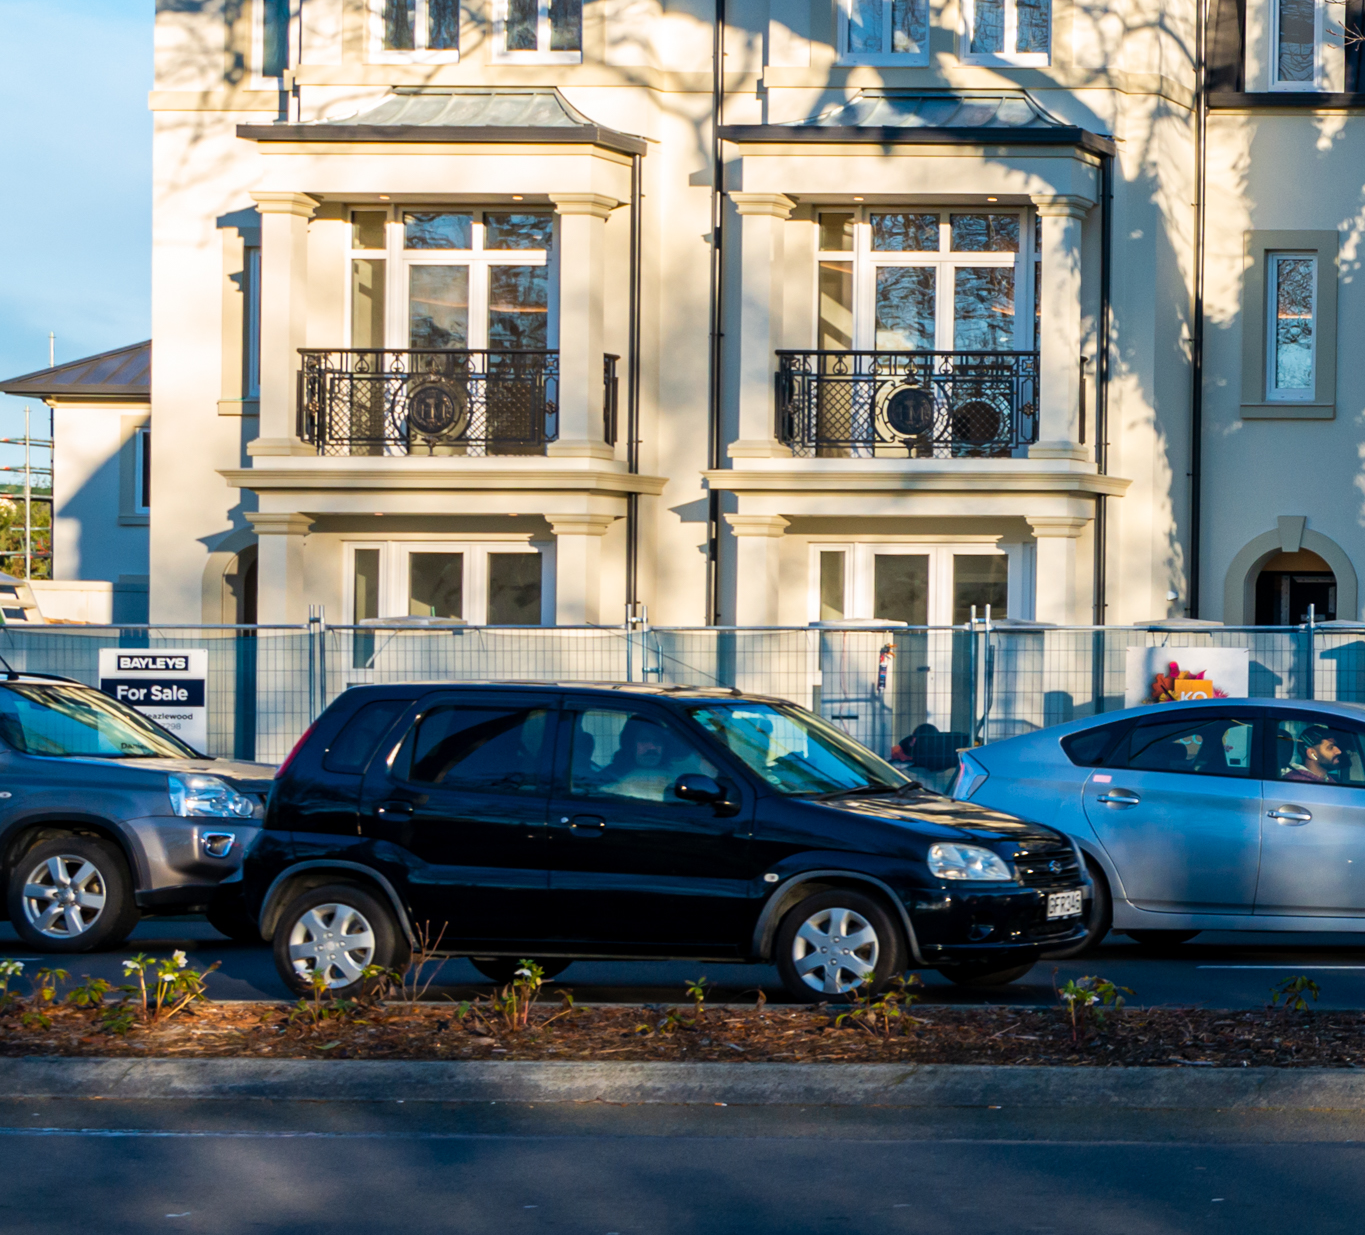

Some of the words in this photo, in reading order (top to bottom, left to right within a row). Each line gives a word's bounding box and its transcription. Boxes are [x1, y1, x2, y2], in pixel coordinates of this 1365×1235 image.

[120, 657, 186, 669] BAYLEYS
[116, 685, 147, 701] For
[150, 685, 189, 701] Sale
